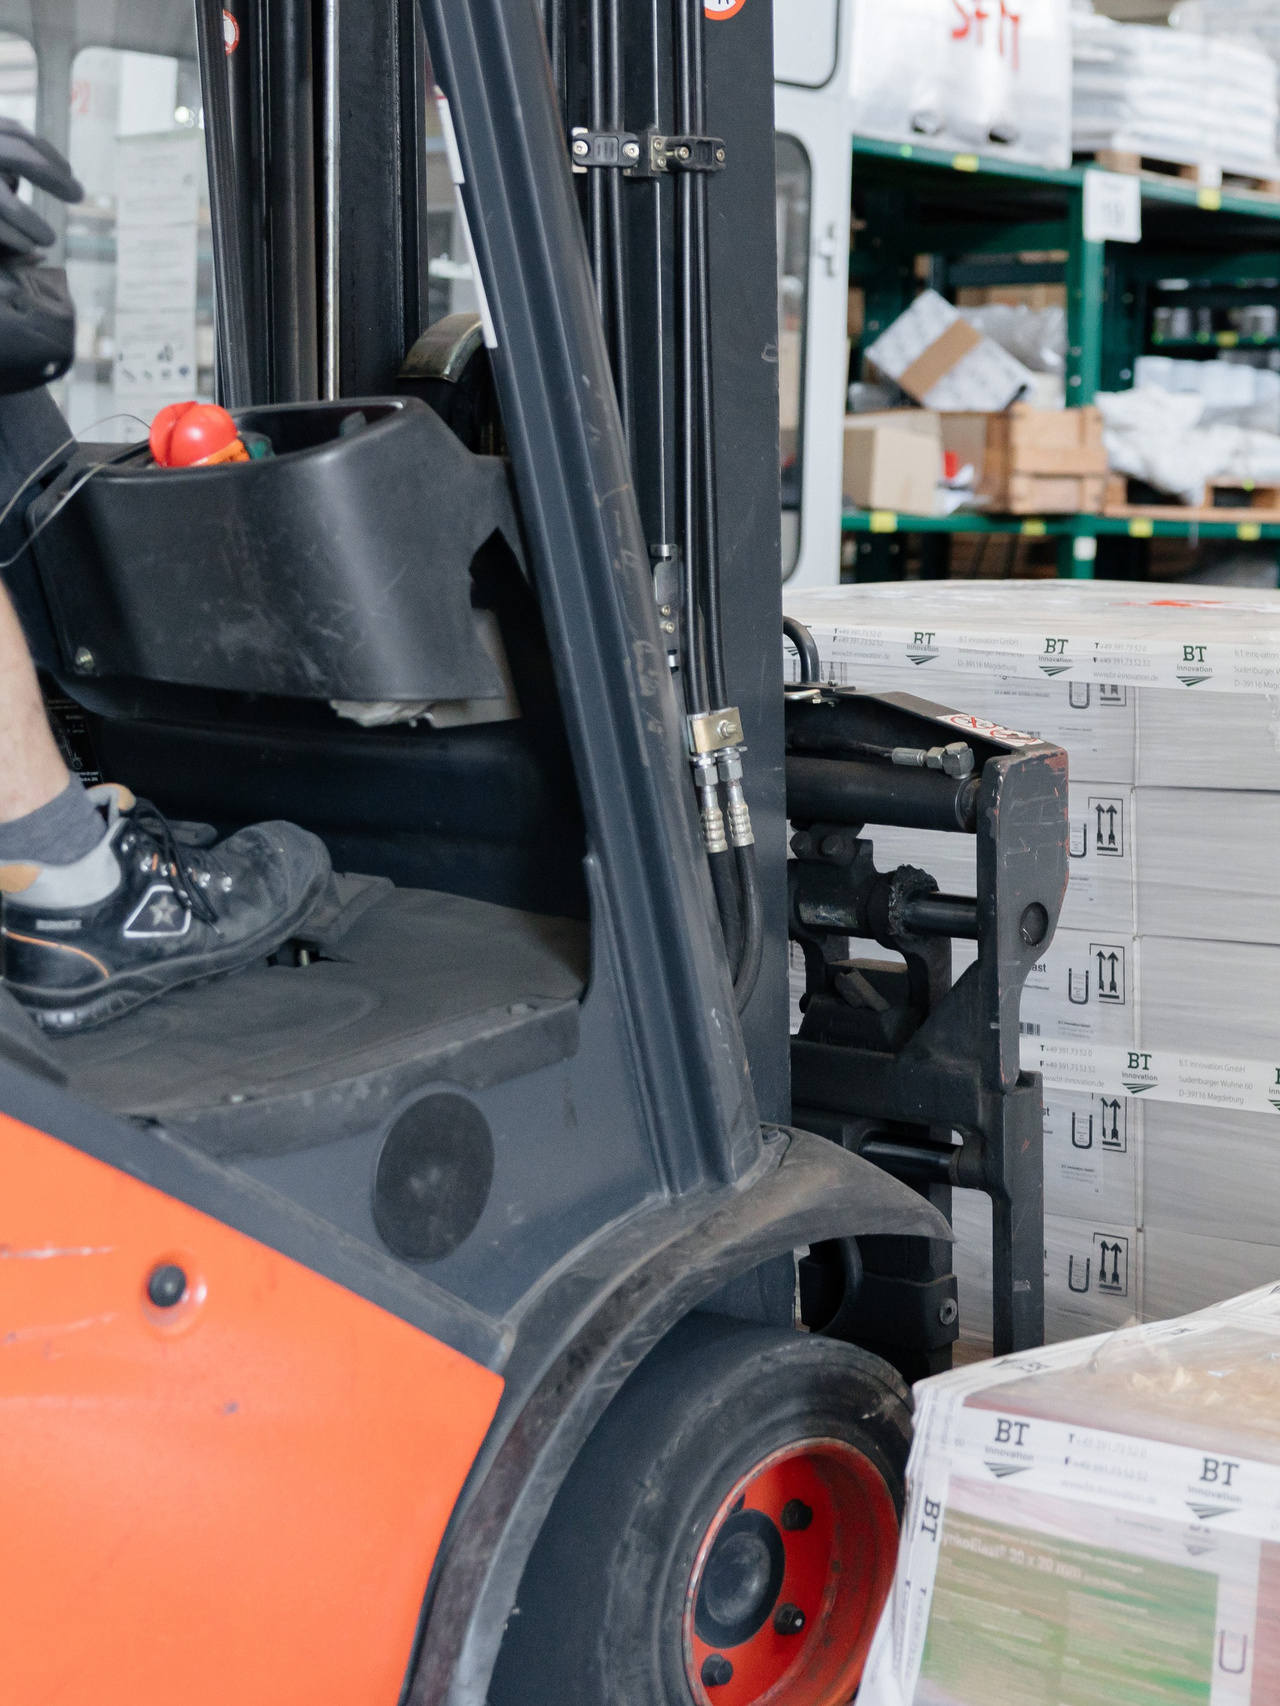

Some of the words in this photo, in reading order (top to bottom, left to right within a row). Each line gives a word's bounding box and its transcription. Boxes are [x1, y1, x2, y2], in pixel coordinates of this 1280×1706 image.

[1045, 638, 1068, 654] BT
[1183, 645, 1207, 662] BT
[1038, 655, 1073, 664] innovation
[1176, 664, 1213, 673] innovation
[1127, 1051, 1152, 1070] BT
[1122, 1072, 1158, 1081] innovation
[994, 1418, 1030, 1446] BT
[984, 1446, 1034, 1462] innovation
[1200, 1457, 1239, 1486] BT
[1189, 1485, 1242, 1503] innovation
[922, 1496, 941, 1542] BT
